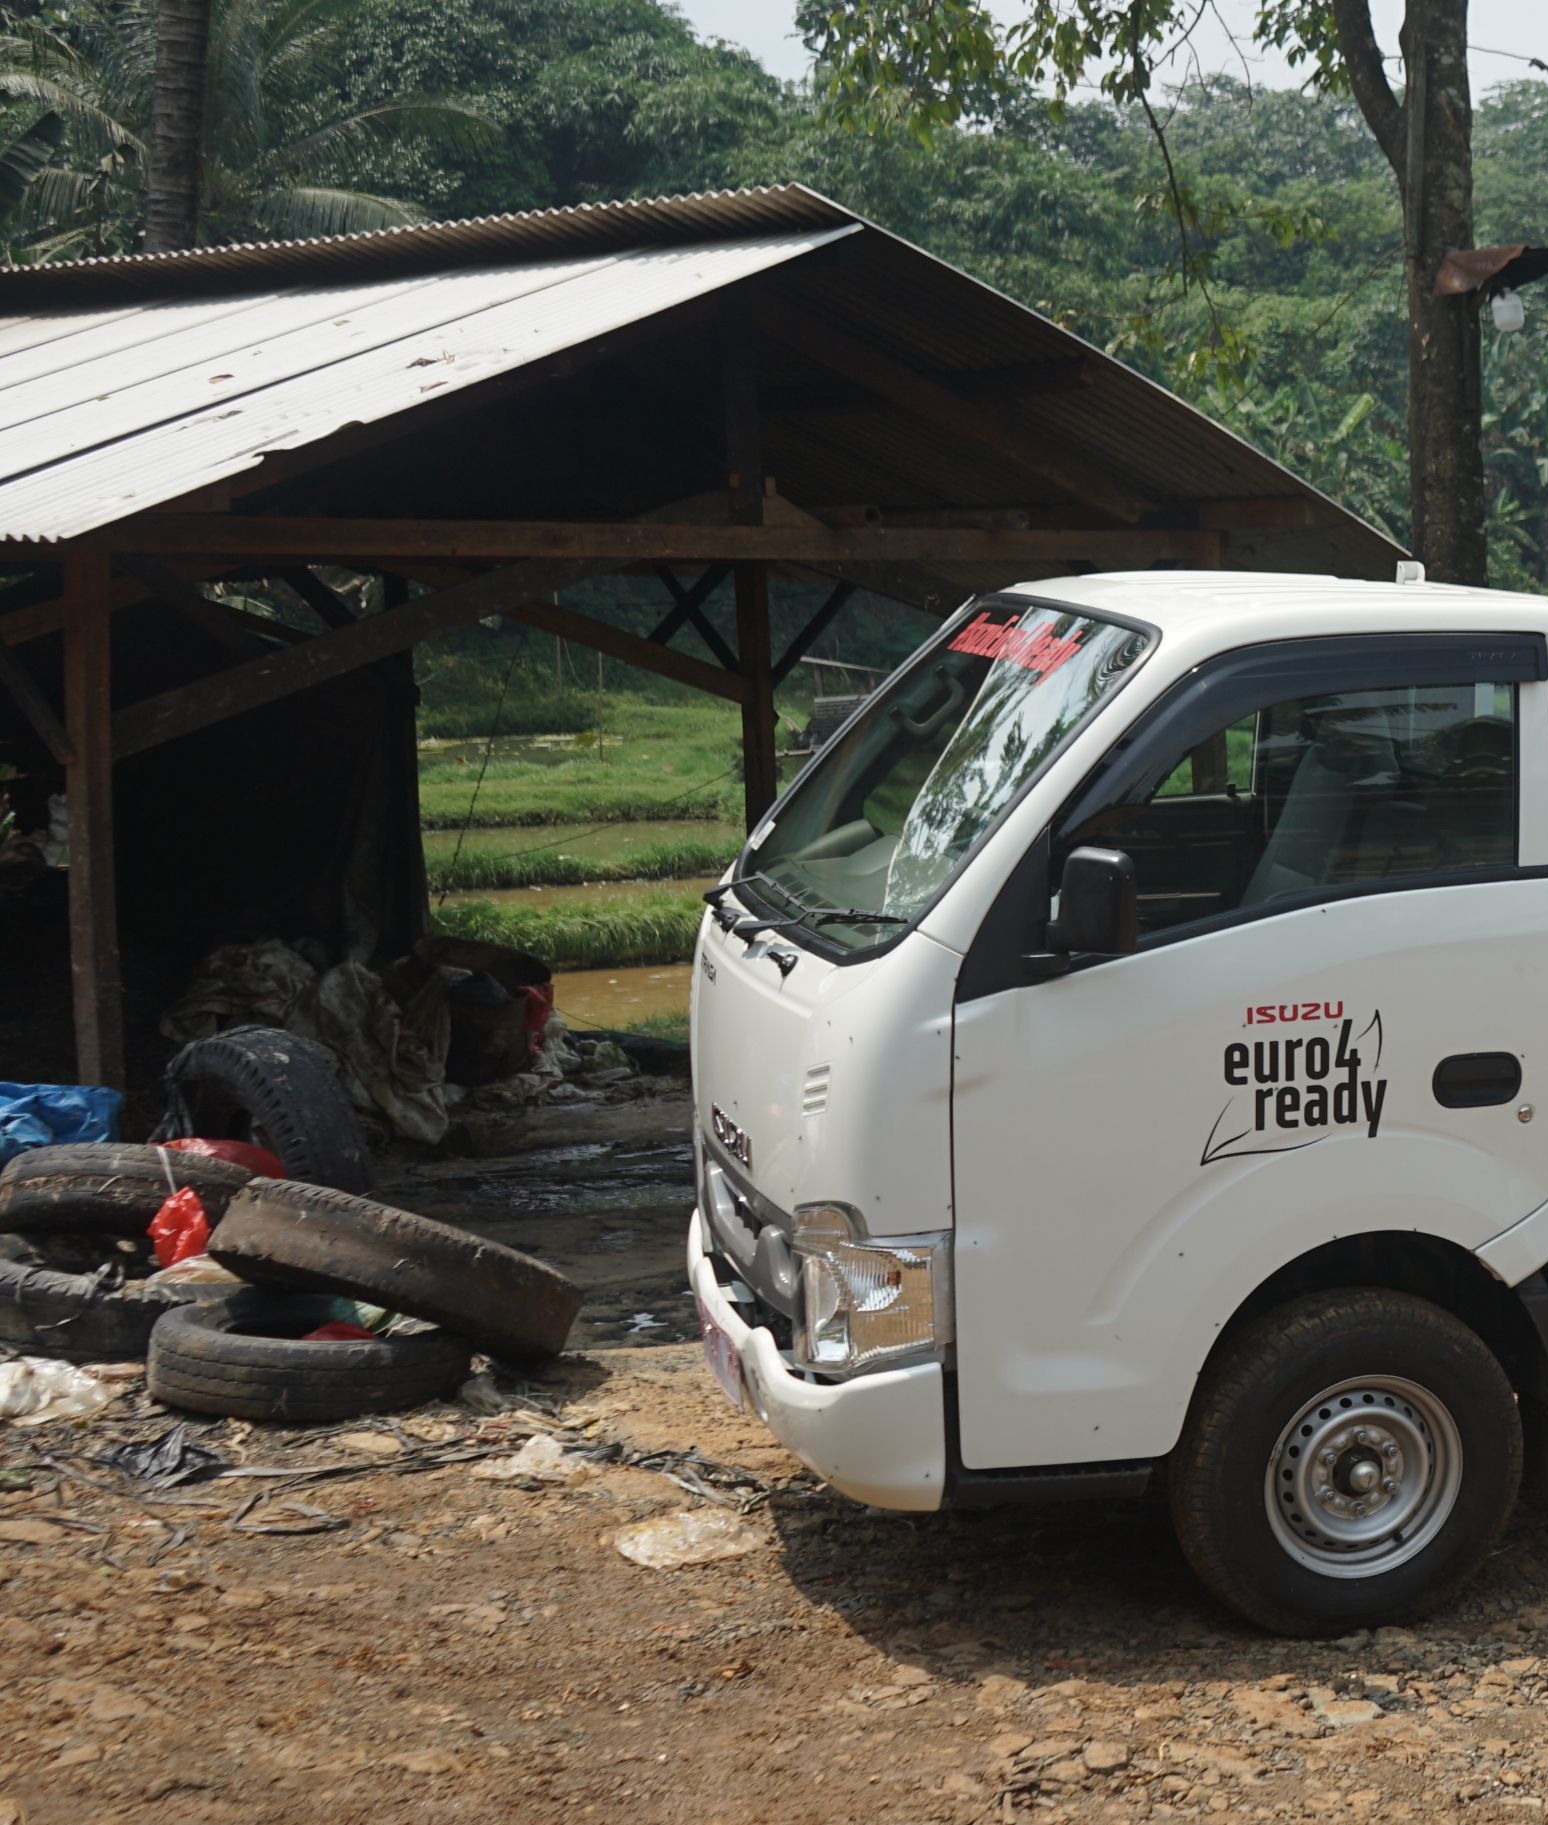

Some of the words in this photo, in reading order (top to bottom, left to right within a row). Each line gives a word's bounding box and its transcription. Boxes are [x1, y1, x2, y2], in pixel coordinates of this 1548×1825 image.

[1247, 1001, 1343, 1024] ISUZU
[1224, 1019, 1361, 1085] euro4
[1255, 1065, 1387, 1138] ready
